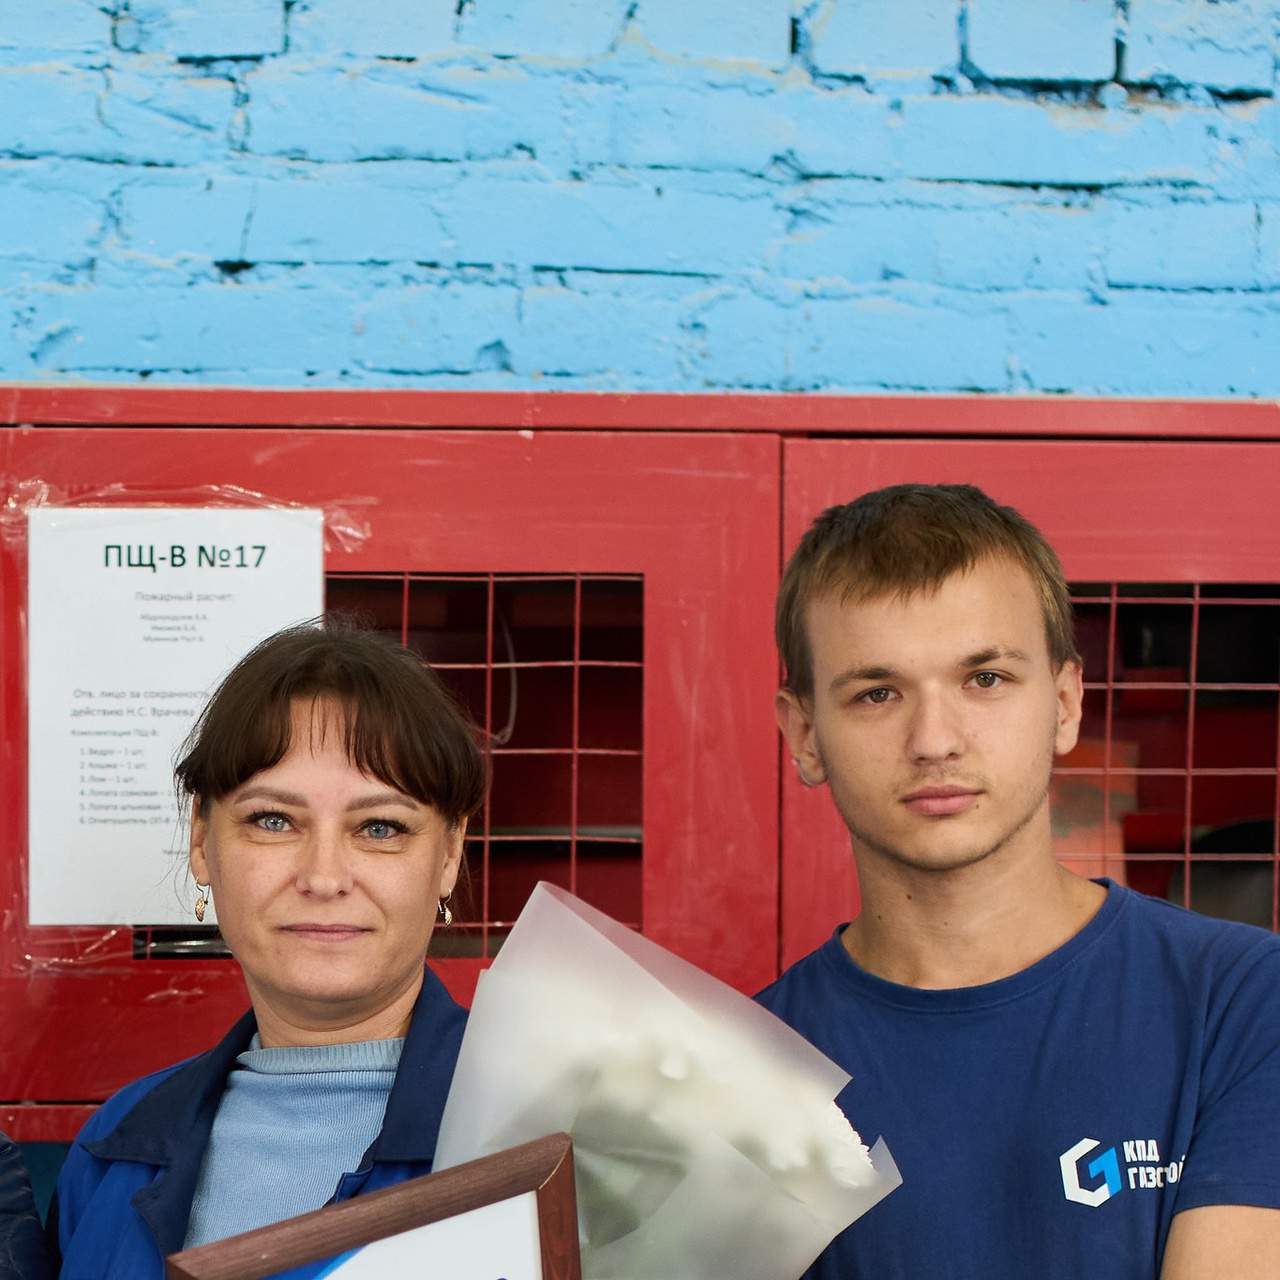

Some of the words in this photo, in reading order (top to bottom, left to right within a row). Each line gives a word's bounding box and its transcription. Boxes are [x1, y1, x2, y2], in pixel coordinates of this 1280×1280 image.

[104, 545, 186, 573] ПЩ-В
[198, 545, 267, 568] №17
[135, 592, 193, 602] Пожарный
[99, 690, 126, 700] лицо
[130, 690, 141, 699] за
[71, 706, 122, 718] действию
[1123, 1140, 1160, 1162] КПД
